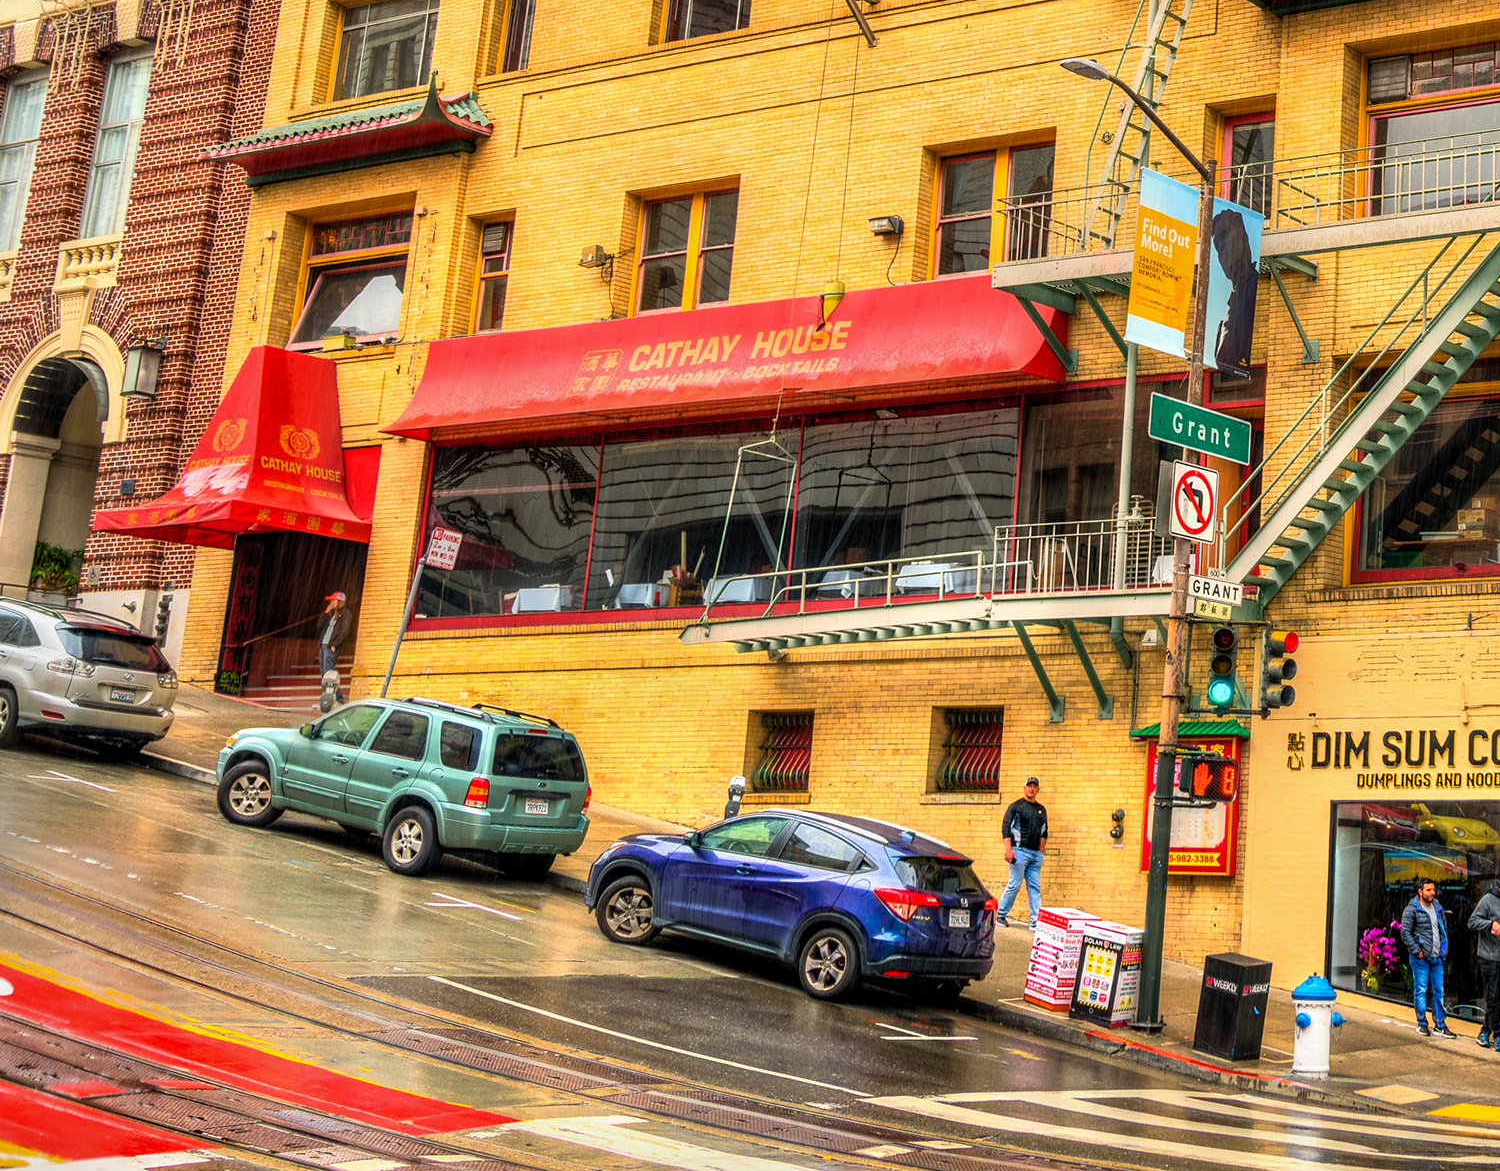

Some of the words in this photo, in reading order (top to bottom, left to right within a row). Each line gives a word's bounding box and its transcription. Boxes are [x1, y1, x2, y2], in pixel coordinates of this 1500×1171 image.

[1143, 218, 1167, 240] Find
[1168, 229, 1190, 249] Out
[1141, 233, 1173, 258] More!
[1139, 256, 1149, 264] SAN
[1138, 269, 1163, 282] MEMORIAL
[629, 334, 741, 372] CATHAY
[750, 321, 852, 359] HOUSE
[616, 368, 726, 393] RESTAURANT
[745, 357, 839, 380] COCKTAILS
[1173, 412, 1230, 449] Grant
[189, 456, 220, 472] CATHAY
[222, 454, 251, 467] HOUSE
[261, 455, 302, 475] CATHAY
[306, 465, 341, 483] HOUSE
[264, 480, 305, 493] RESTAURANT
[310, 489, 344, 501] COCKTAILS
[444, 534, 460, 544] PARKING
[1193, 580, 1239, 600] GRANT
[1311, 730, 1370, 769] DIM
[1382, 730, 1455, 768] SUM
[1357, 773, 1432, 789] DUMPLINGS
[1436, 772, 1462, 788] AND
[1168, 855, 1214, 863] 5-982-3388
[1084, 937, 1103, 947] DOLAN
